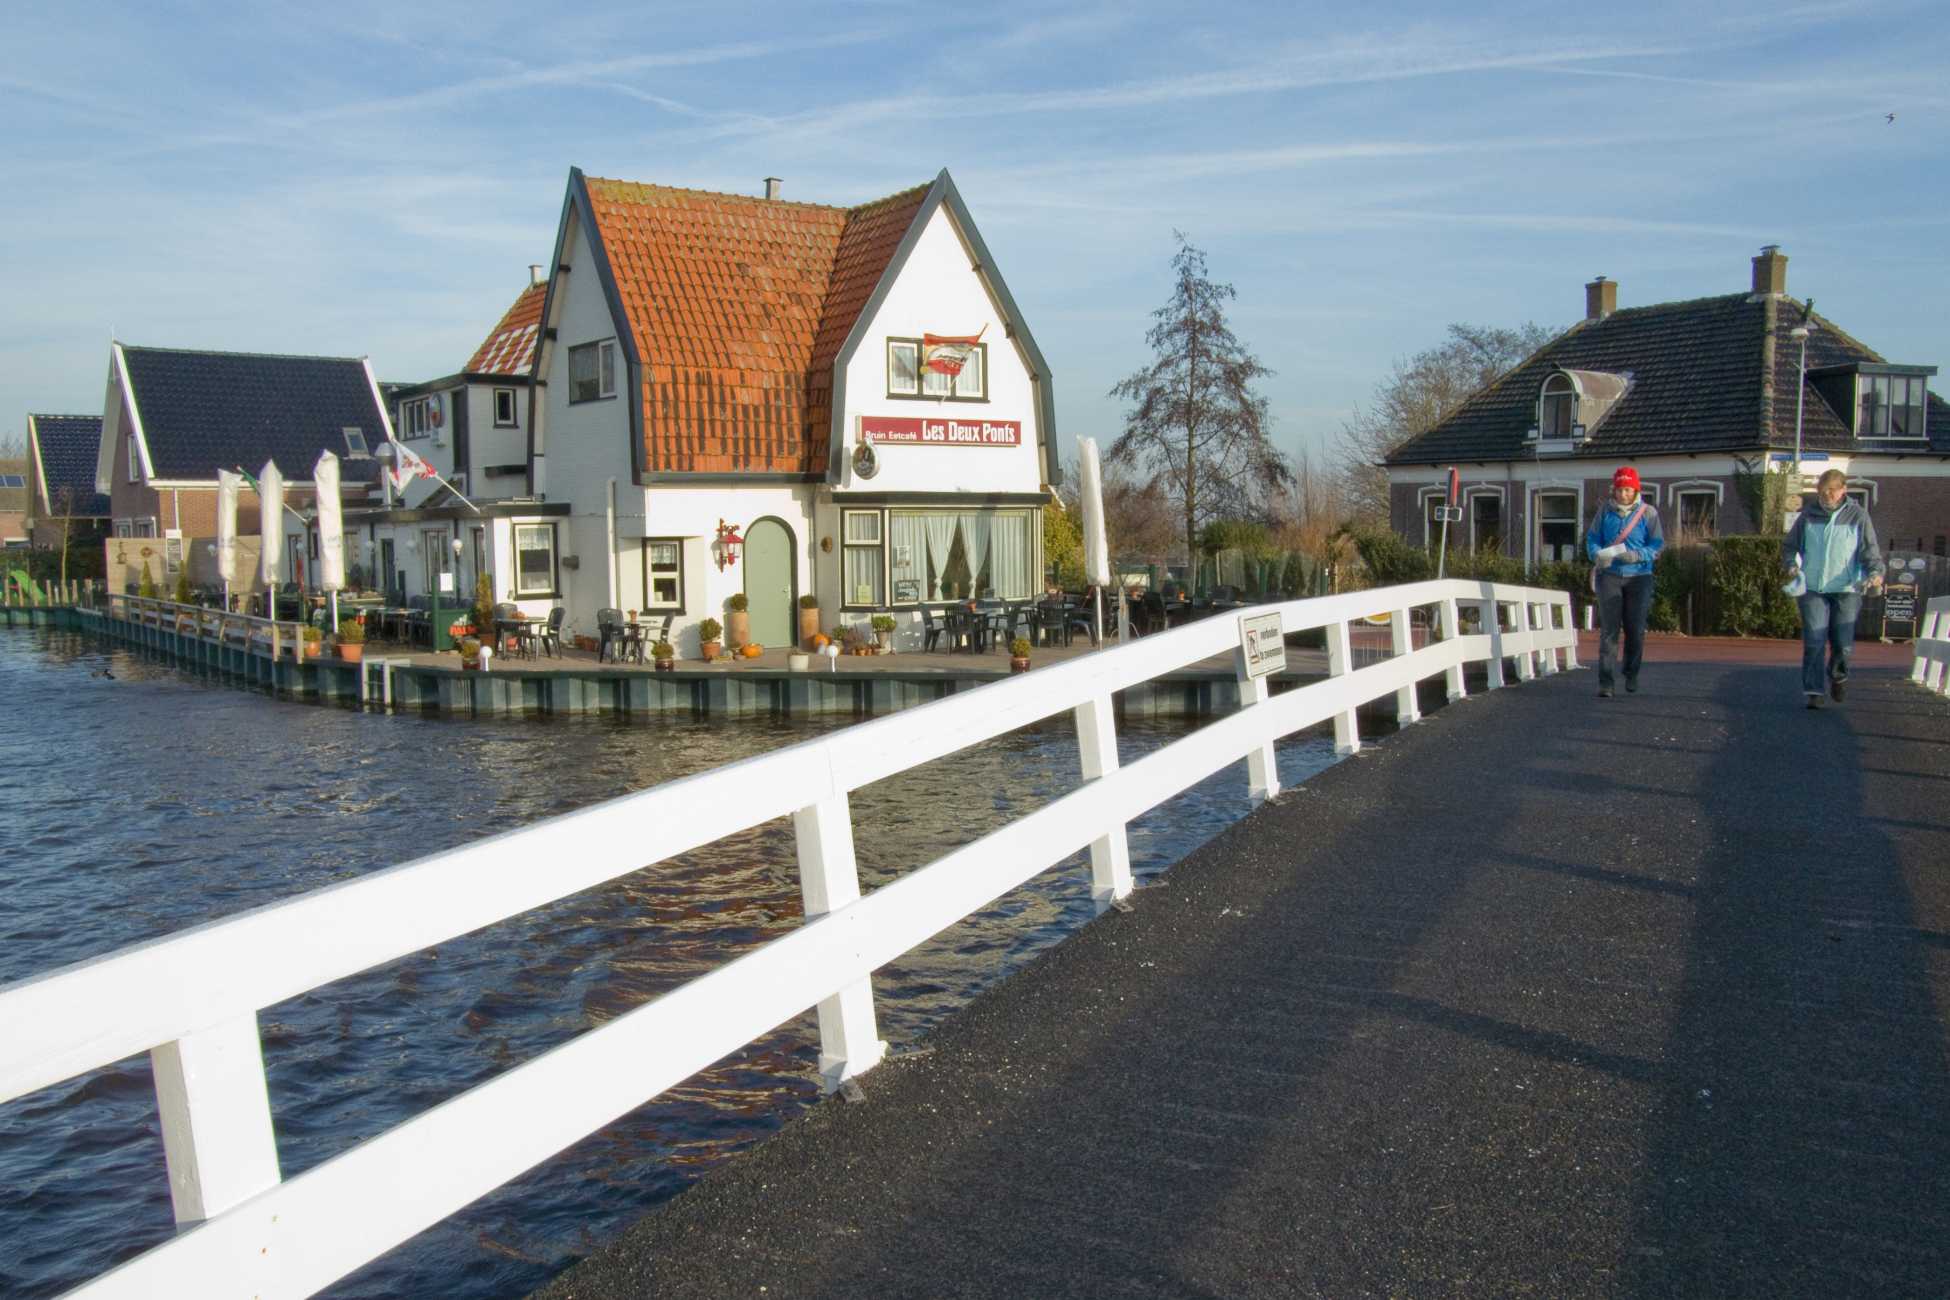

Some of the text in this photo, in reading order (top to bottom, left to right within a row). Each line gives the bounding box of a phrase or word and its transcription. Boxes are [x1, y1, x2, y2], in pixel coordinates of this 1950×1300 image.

[922, 420, 945, 441] Les
[948, 421, 980, 441] Deux
[982, 423, 1015, 442] Ponts
